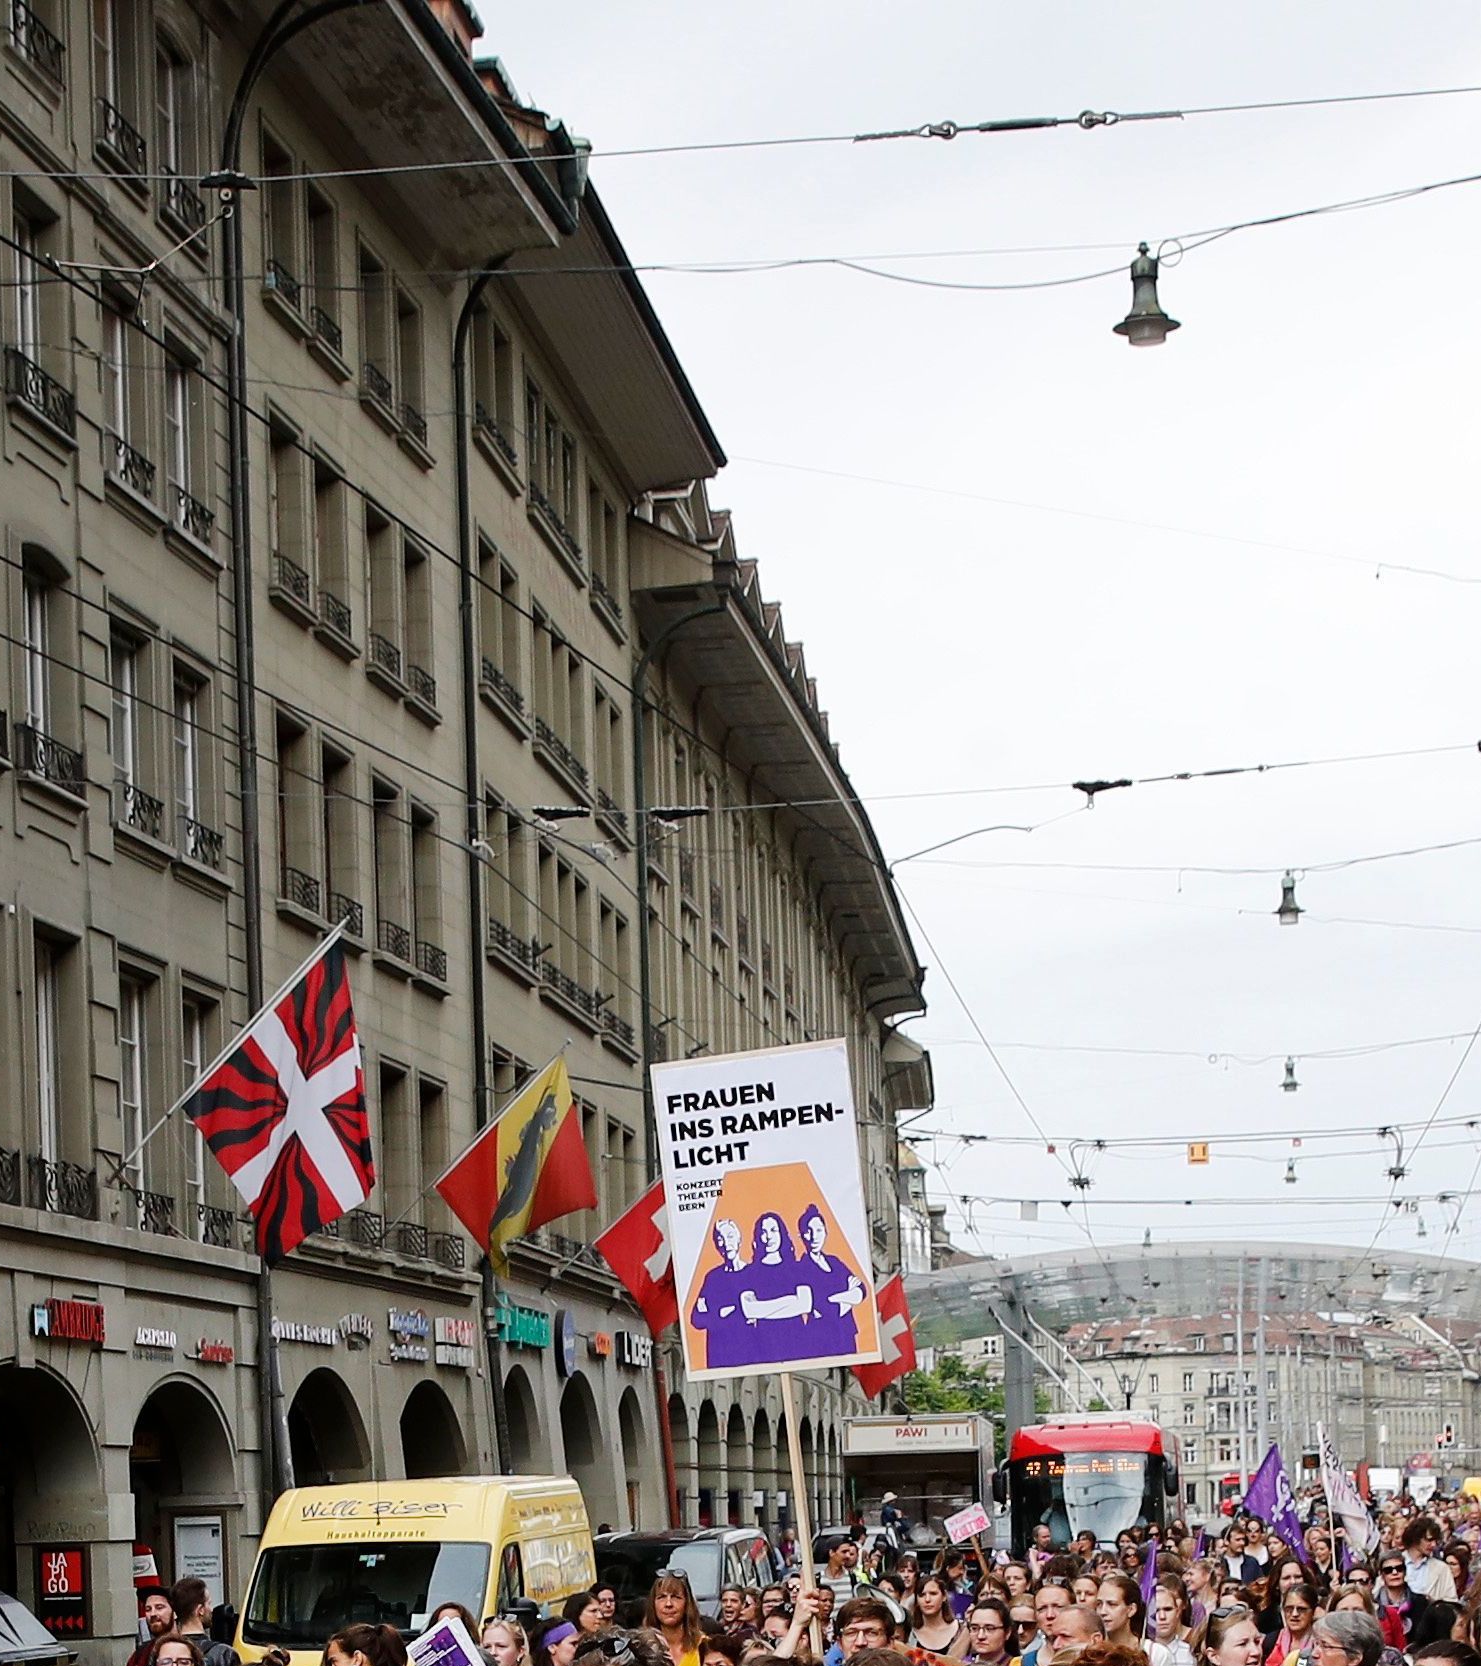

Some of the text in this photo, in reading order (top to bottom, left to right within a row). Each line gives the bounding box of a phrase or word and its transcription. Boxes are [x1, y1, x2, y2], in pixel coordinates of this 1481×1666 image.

[667, 1082, 775, 1115] FRAUEN
[670, 1102, 844, 1142] INS RAMPEN-
[673, 1141, 750, 1170] LICHT
[676, 1178, 724, 1191] KONZERT
[678, 1189, 723, 1201] THEATER
[678, 1202, 706, 1212] BERN
[895, 1427, 928, 1438] PAWI
[303, 1500, 359, 1518] Willi
[47, 1552, 68, 1568] JA
[51, 1565, 65, 1580] PI
[47, 1578, 69, 1593] GO
